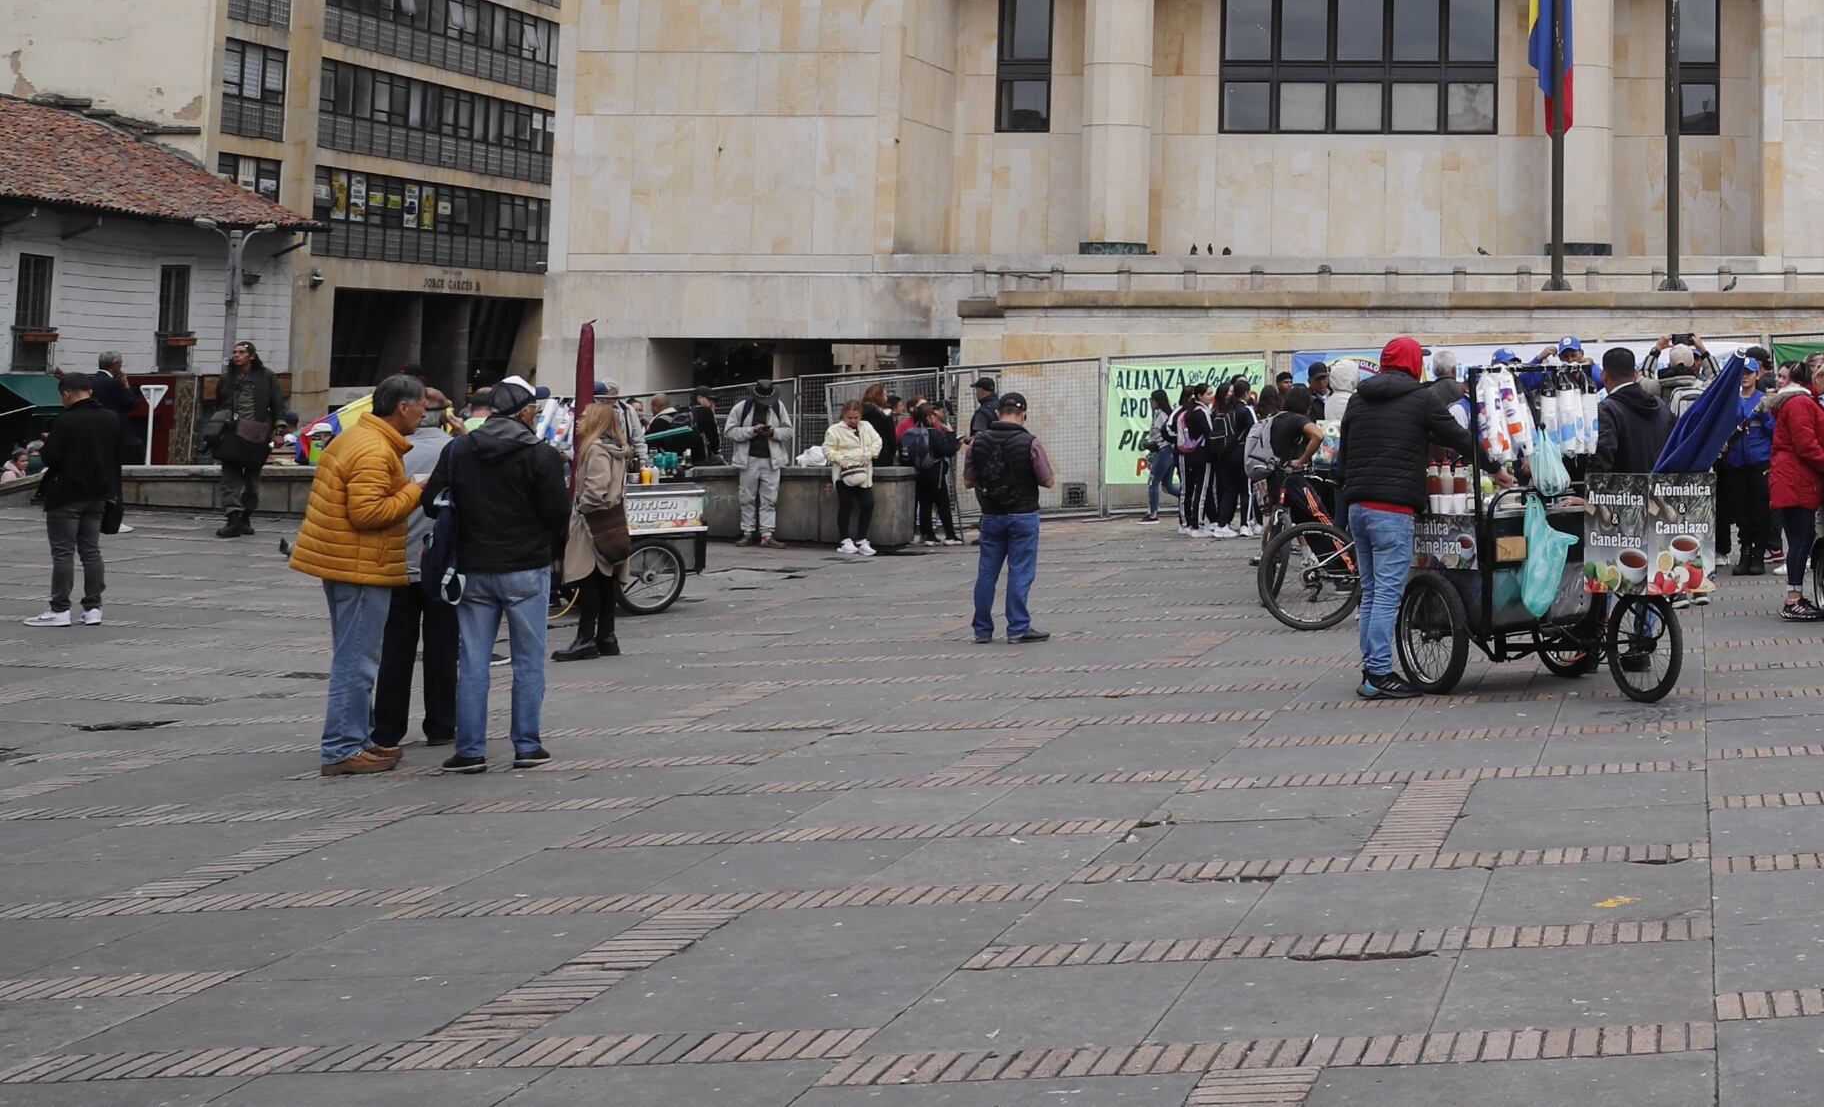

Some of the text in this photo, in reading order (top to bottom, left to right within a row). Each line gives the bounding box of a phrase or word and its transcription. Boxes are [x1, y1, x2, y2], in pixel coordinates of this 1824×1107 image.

[423, 278, 445, 289] JORGE
[1116, 368, 1186, 390] ALIANZA
[1654, 482, 1711, 497] Aromática
[1588, 490, 1644, 506] Aromática
[1678, 502, 1687, 514] &
[627, 511, 697, 523] ANELAZO
[1610, 513, 1620, 525] &
[1655, 520, 1710, 535] Canelazo
[1415, 536, 1462, 555] Canelazo
[1590, 531, 1642, 549] Canelazo
